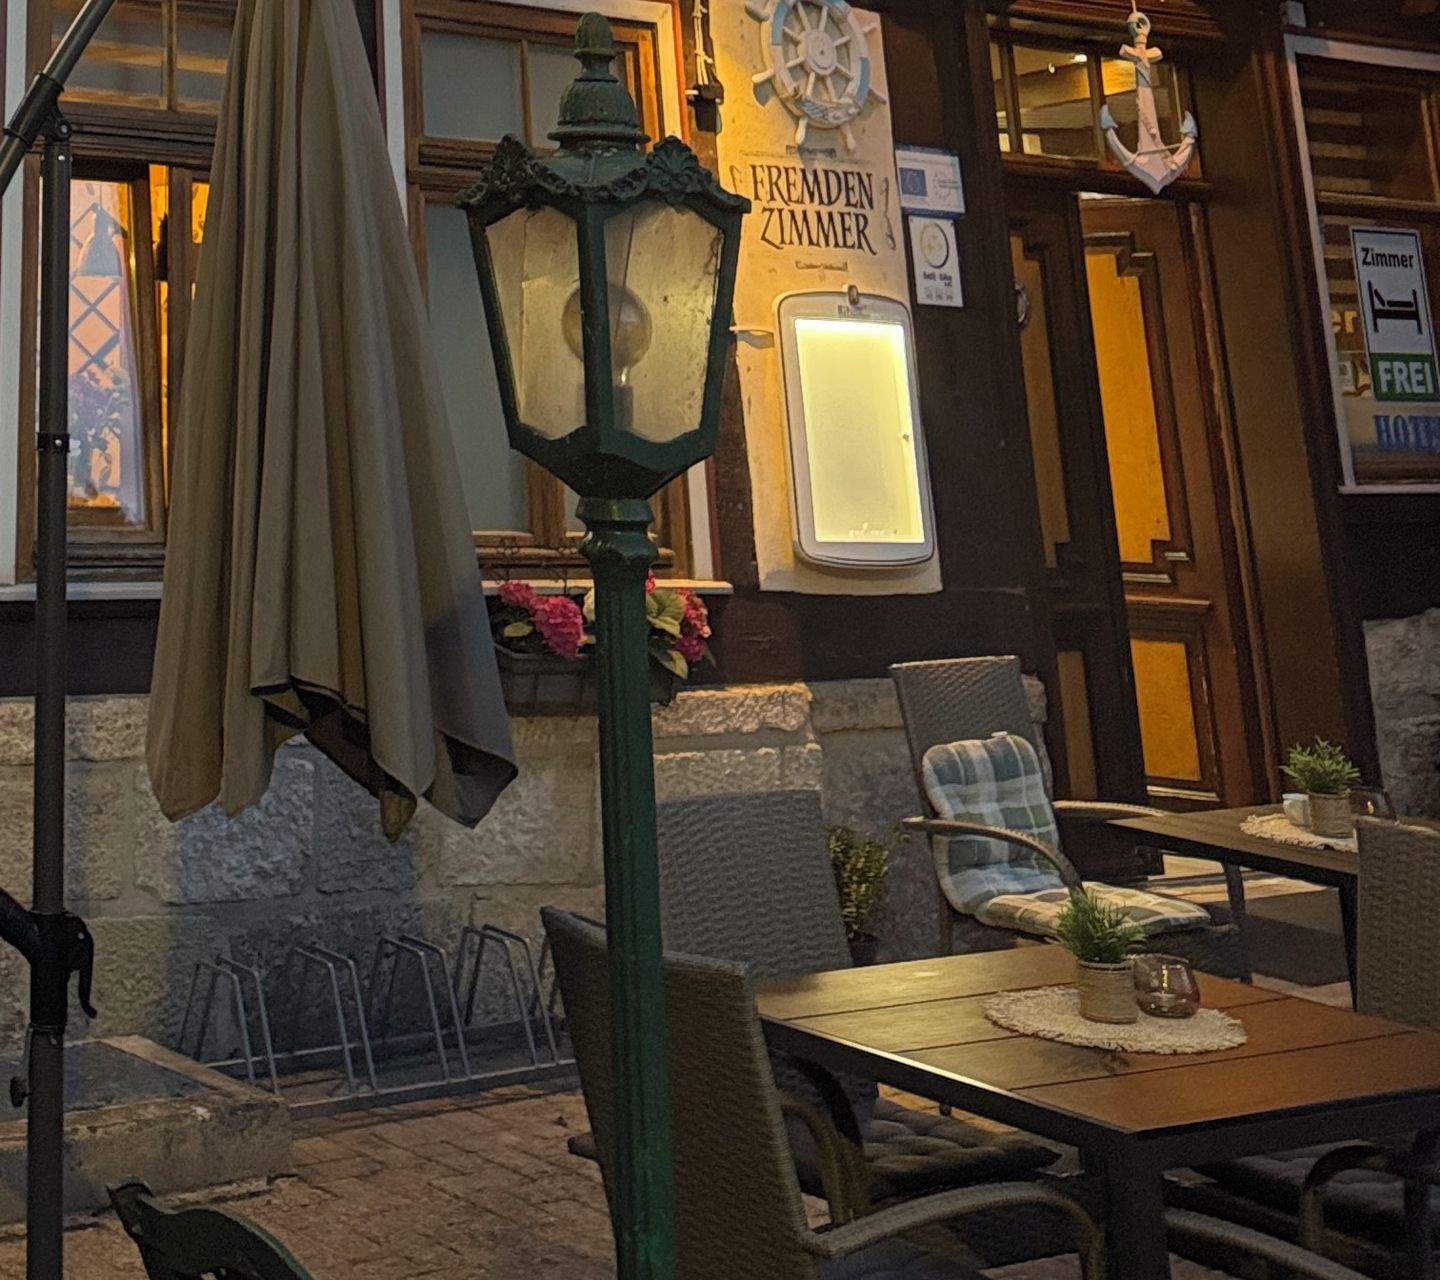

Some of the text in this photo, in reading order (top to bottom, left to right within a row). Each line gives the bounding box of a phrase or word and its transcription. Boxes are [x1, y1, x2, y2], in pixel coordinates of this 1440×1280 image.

[749, 164, 875, 210] FREMDEN
[760, 205, 877, 256] ZIMMER
[1361, 246, 1414, 269] Zimmer
[1377, 360, 1435, 394] FREI
